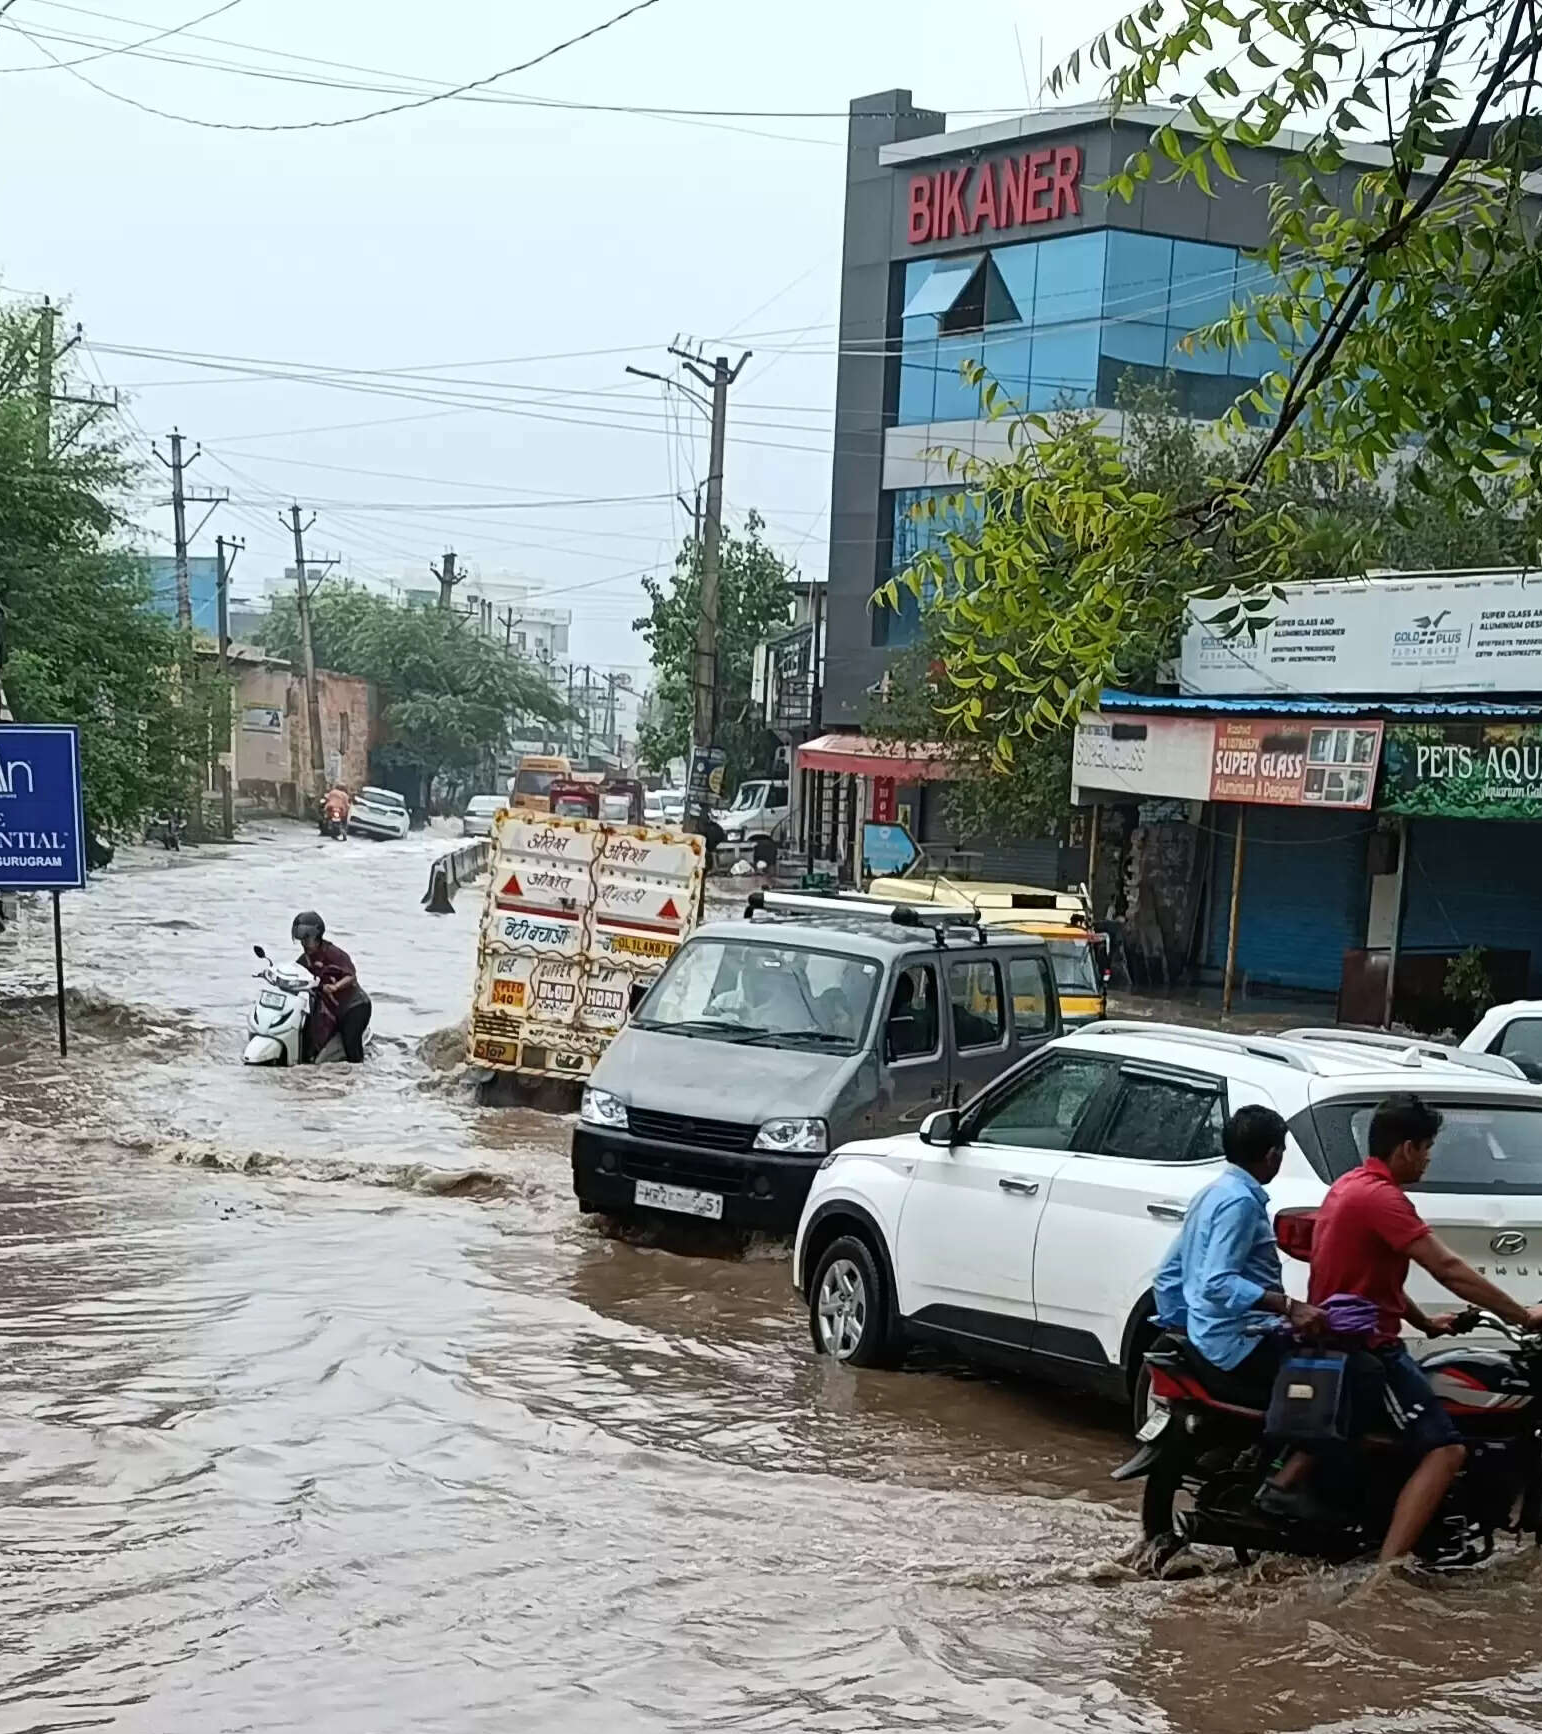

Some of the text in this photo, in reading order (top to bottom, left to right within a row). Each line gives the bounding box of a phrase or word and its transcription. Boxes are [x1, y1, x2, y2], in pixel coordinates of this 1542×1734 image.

[908, 146, 1081, 243] BIKANER
[1481, 611, 1506, 620] SUPER
[1394, 631, 1462, 644] GOLD PLUS
[1215, 750, 1303, 779] SUPER GLASS
[1415, 745, 1473, 779] PETS
[1263, 781, 1300, 802] Designer
[1479, 782, 1525, 800] Aquarium
[497, 958, 518, 974] USE
[587, 989, 622, 1008] HORN
